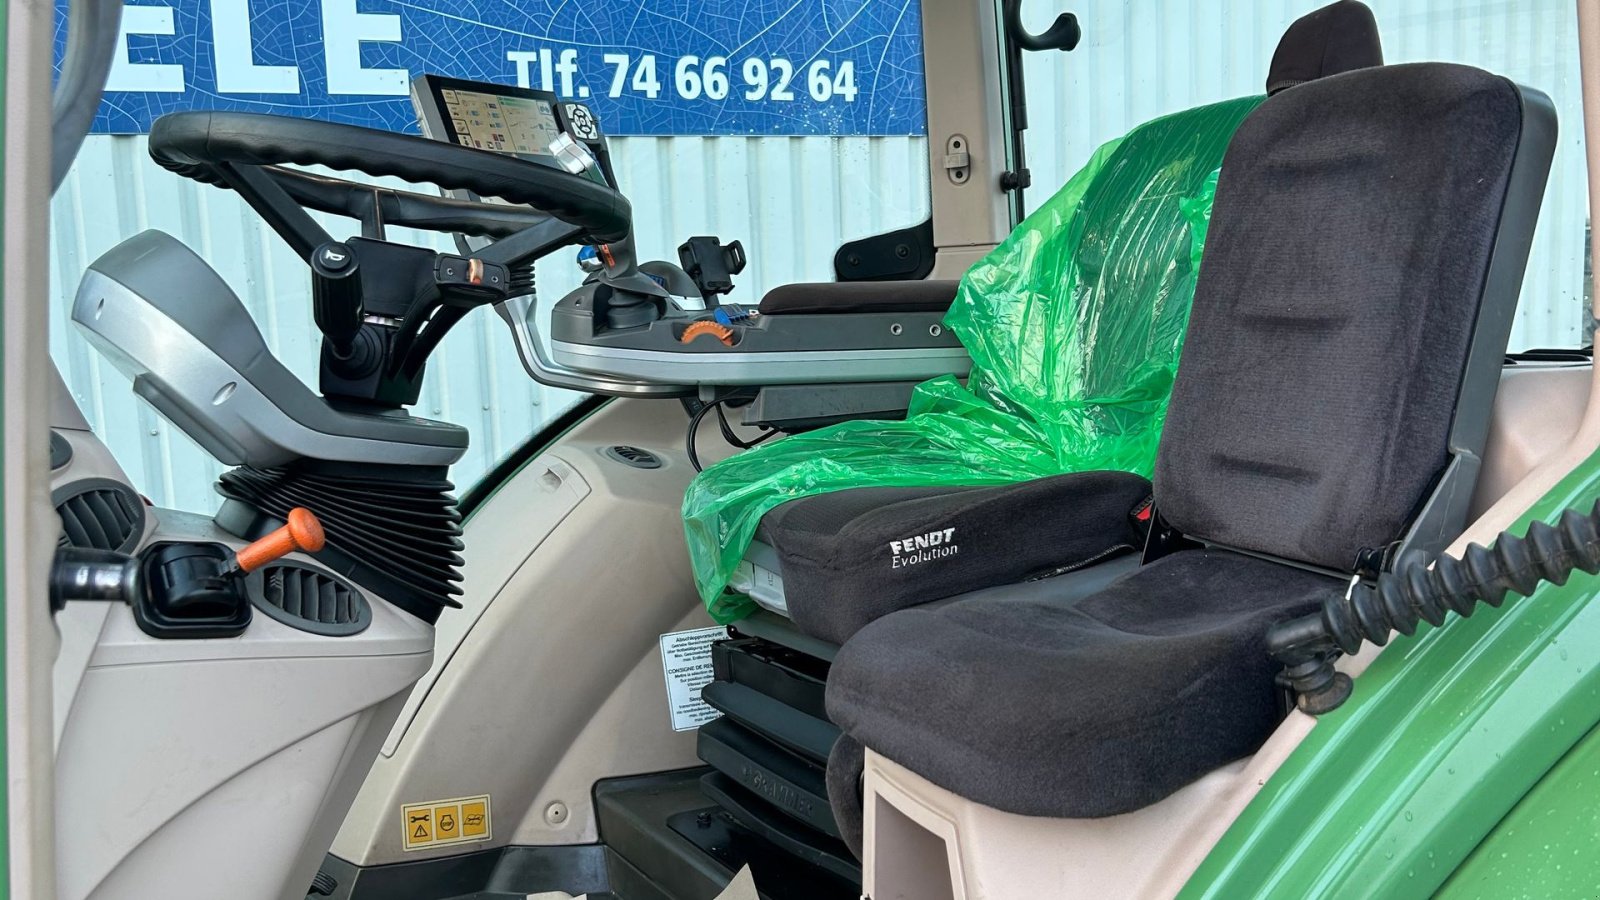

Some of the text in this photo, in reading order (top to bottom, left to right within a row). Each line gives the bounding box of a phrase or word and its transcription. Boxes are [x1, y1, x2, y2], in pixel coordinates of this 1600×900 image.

[102, 0, 410, 95] ELE
[507, 49, 858, 102] Tlf. 74 66 92 64
[889, 527, 956, 555] FENDT
[891, 545, 958, 569] Evolution
